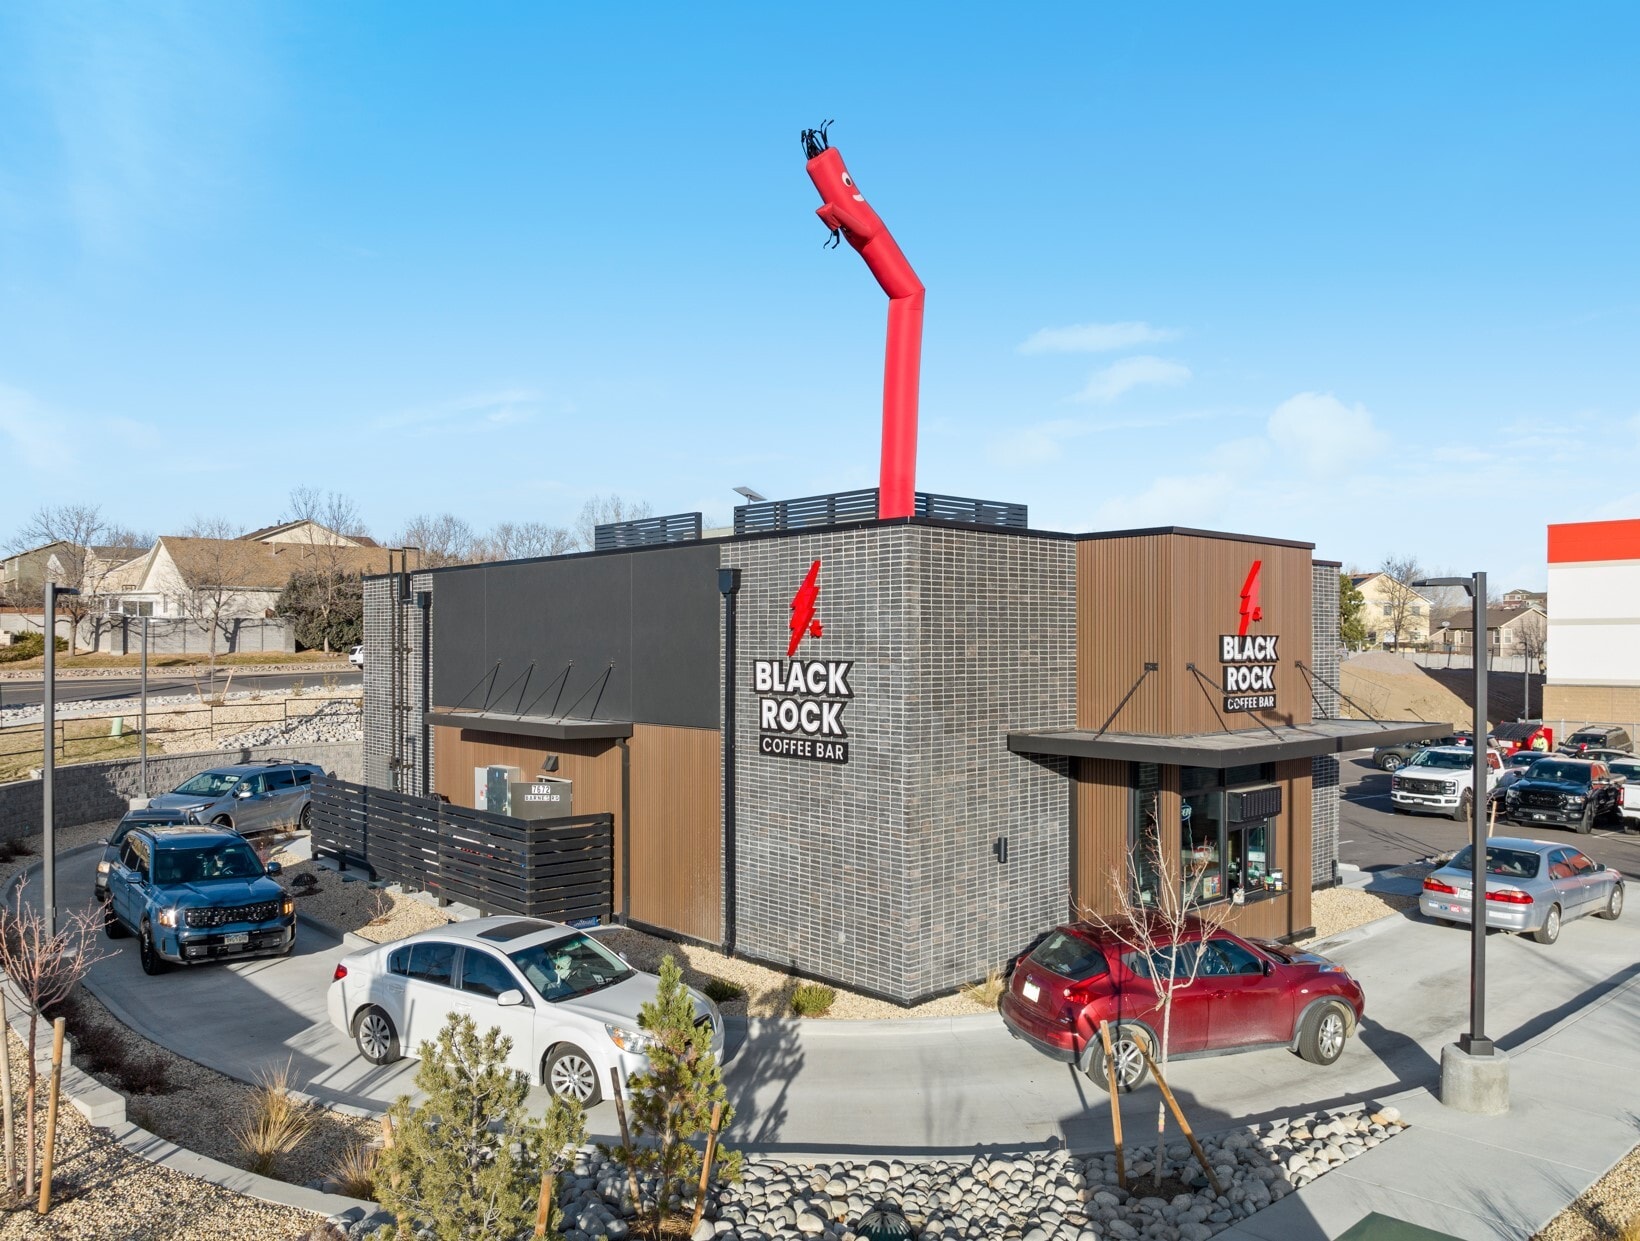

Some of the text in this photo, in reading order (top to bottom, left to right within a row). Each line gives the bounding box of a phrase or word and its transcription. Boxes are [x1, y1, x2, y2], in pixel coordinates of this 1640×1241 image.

[1223, 635, 1277, 660] BLACK
[755, 661, 849, 695] BLACK
[1227, 666, 1274, 691] ROCK
[1227, 695, 1274, 710] COFFEE BAR
[761, 699, 842, 735] ROCK
[762, 737, 844, 760] COFFEE BAR
[532, 785, 550, 794] 7672
